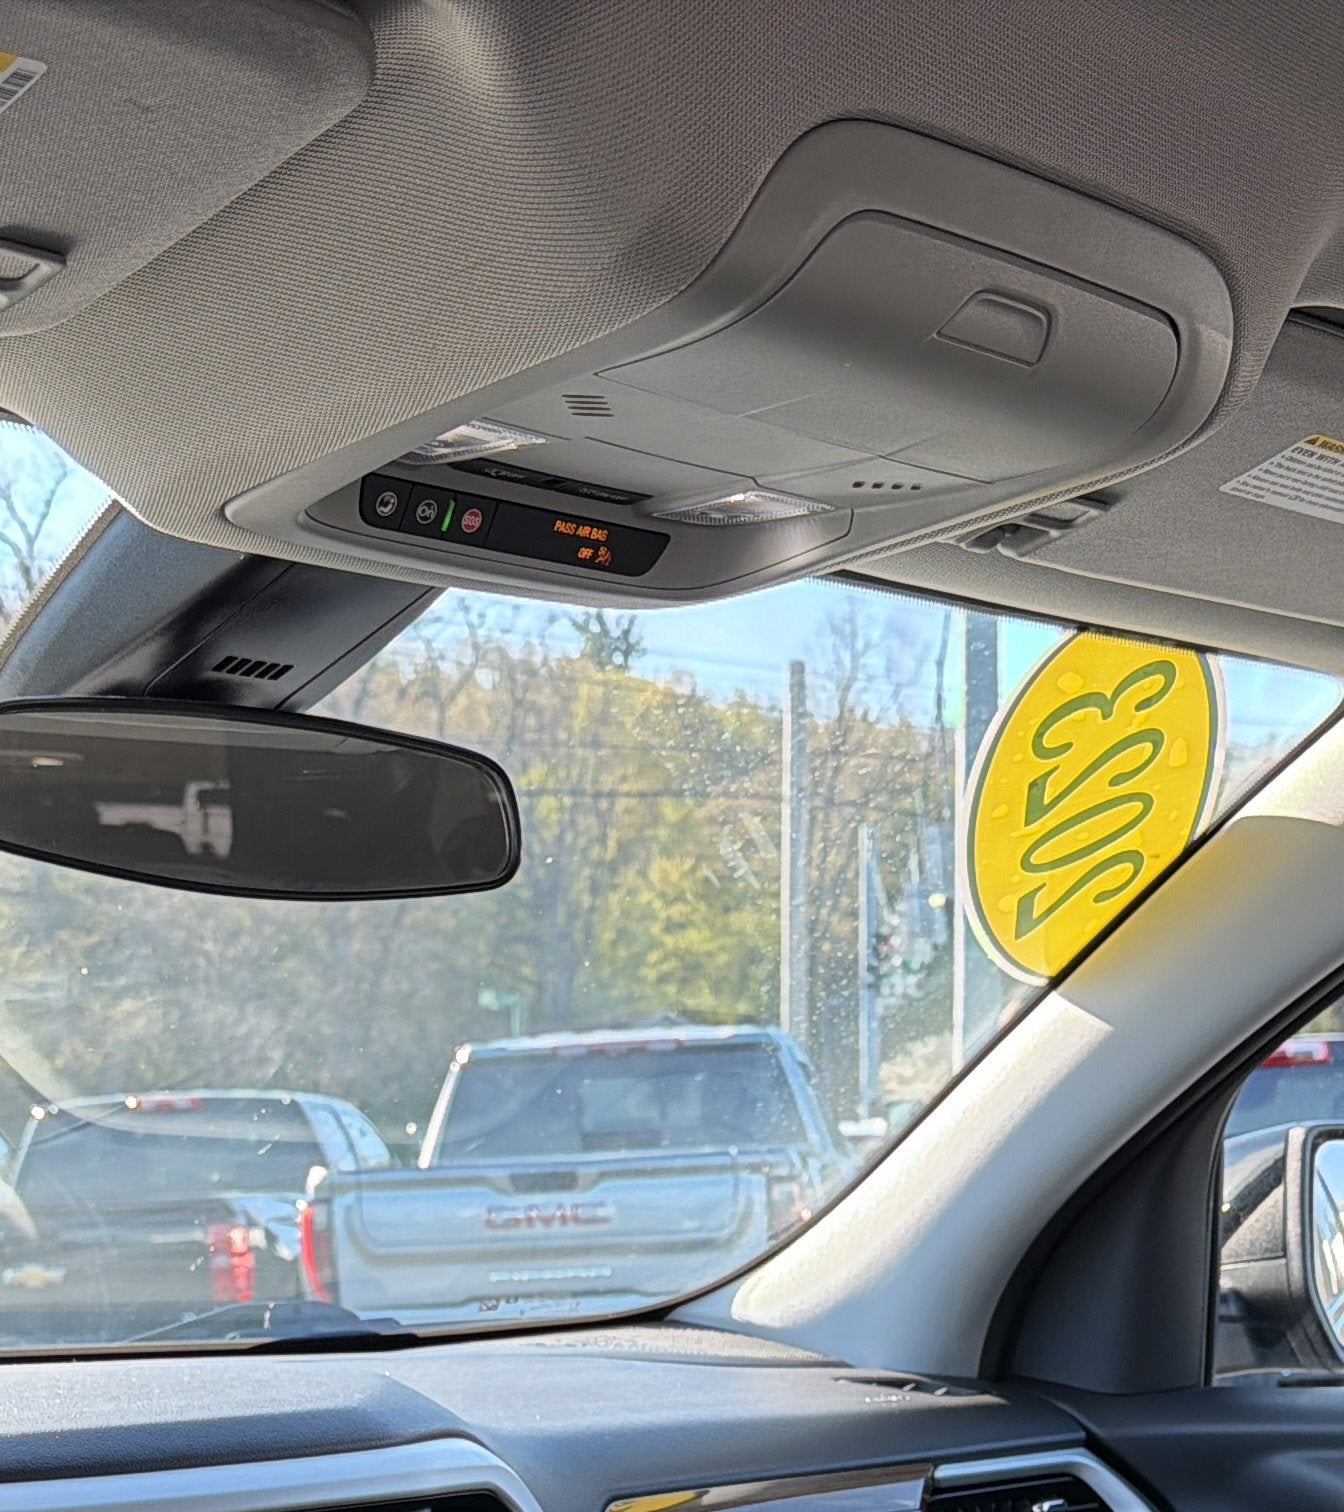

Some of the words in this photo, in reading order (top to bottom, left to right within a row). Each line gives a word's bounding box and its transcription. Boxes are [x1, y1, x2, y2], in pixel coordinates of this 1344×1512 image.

[554, 520, 576, 535] PASS
[577, 526, 593, 538] AIR
[591, 529, 608, 542] BAG
[577, 547, 594, 559] OFF
[485, 1201, 613, 1229] GMC
